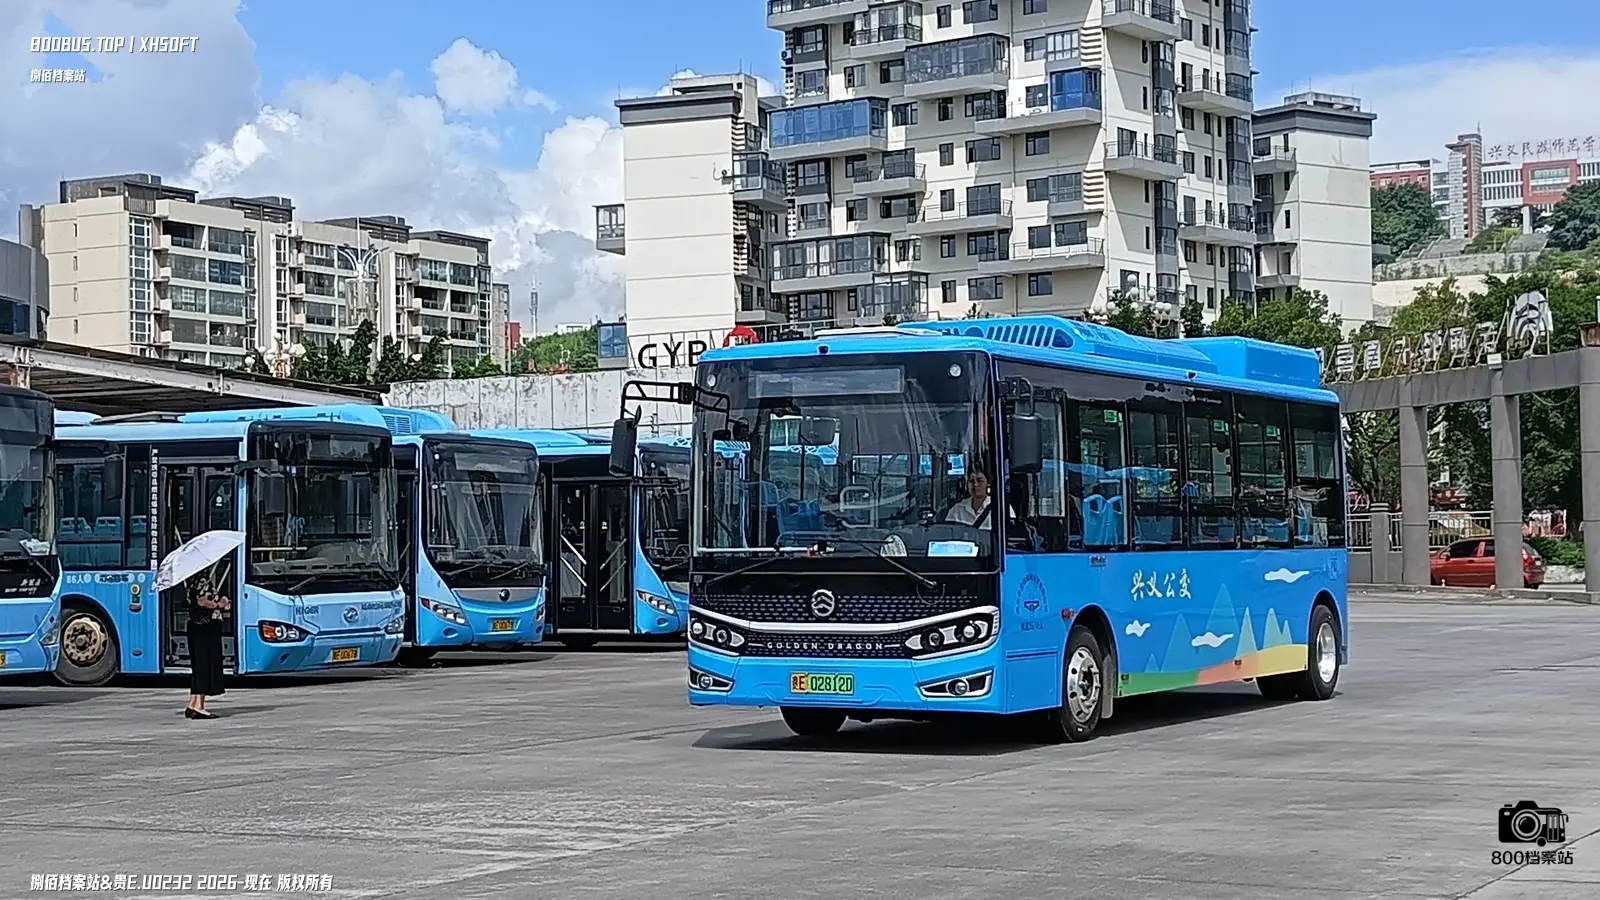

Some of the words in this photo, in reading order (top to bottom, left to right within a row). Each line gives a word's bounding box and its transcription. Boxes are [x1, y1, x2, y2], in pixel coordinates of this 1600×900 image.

[1488, 136, 1600, 158] 兴义民族师范学
[767, 642, 818, 650] GOLDEN
